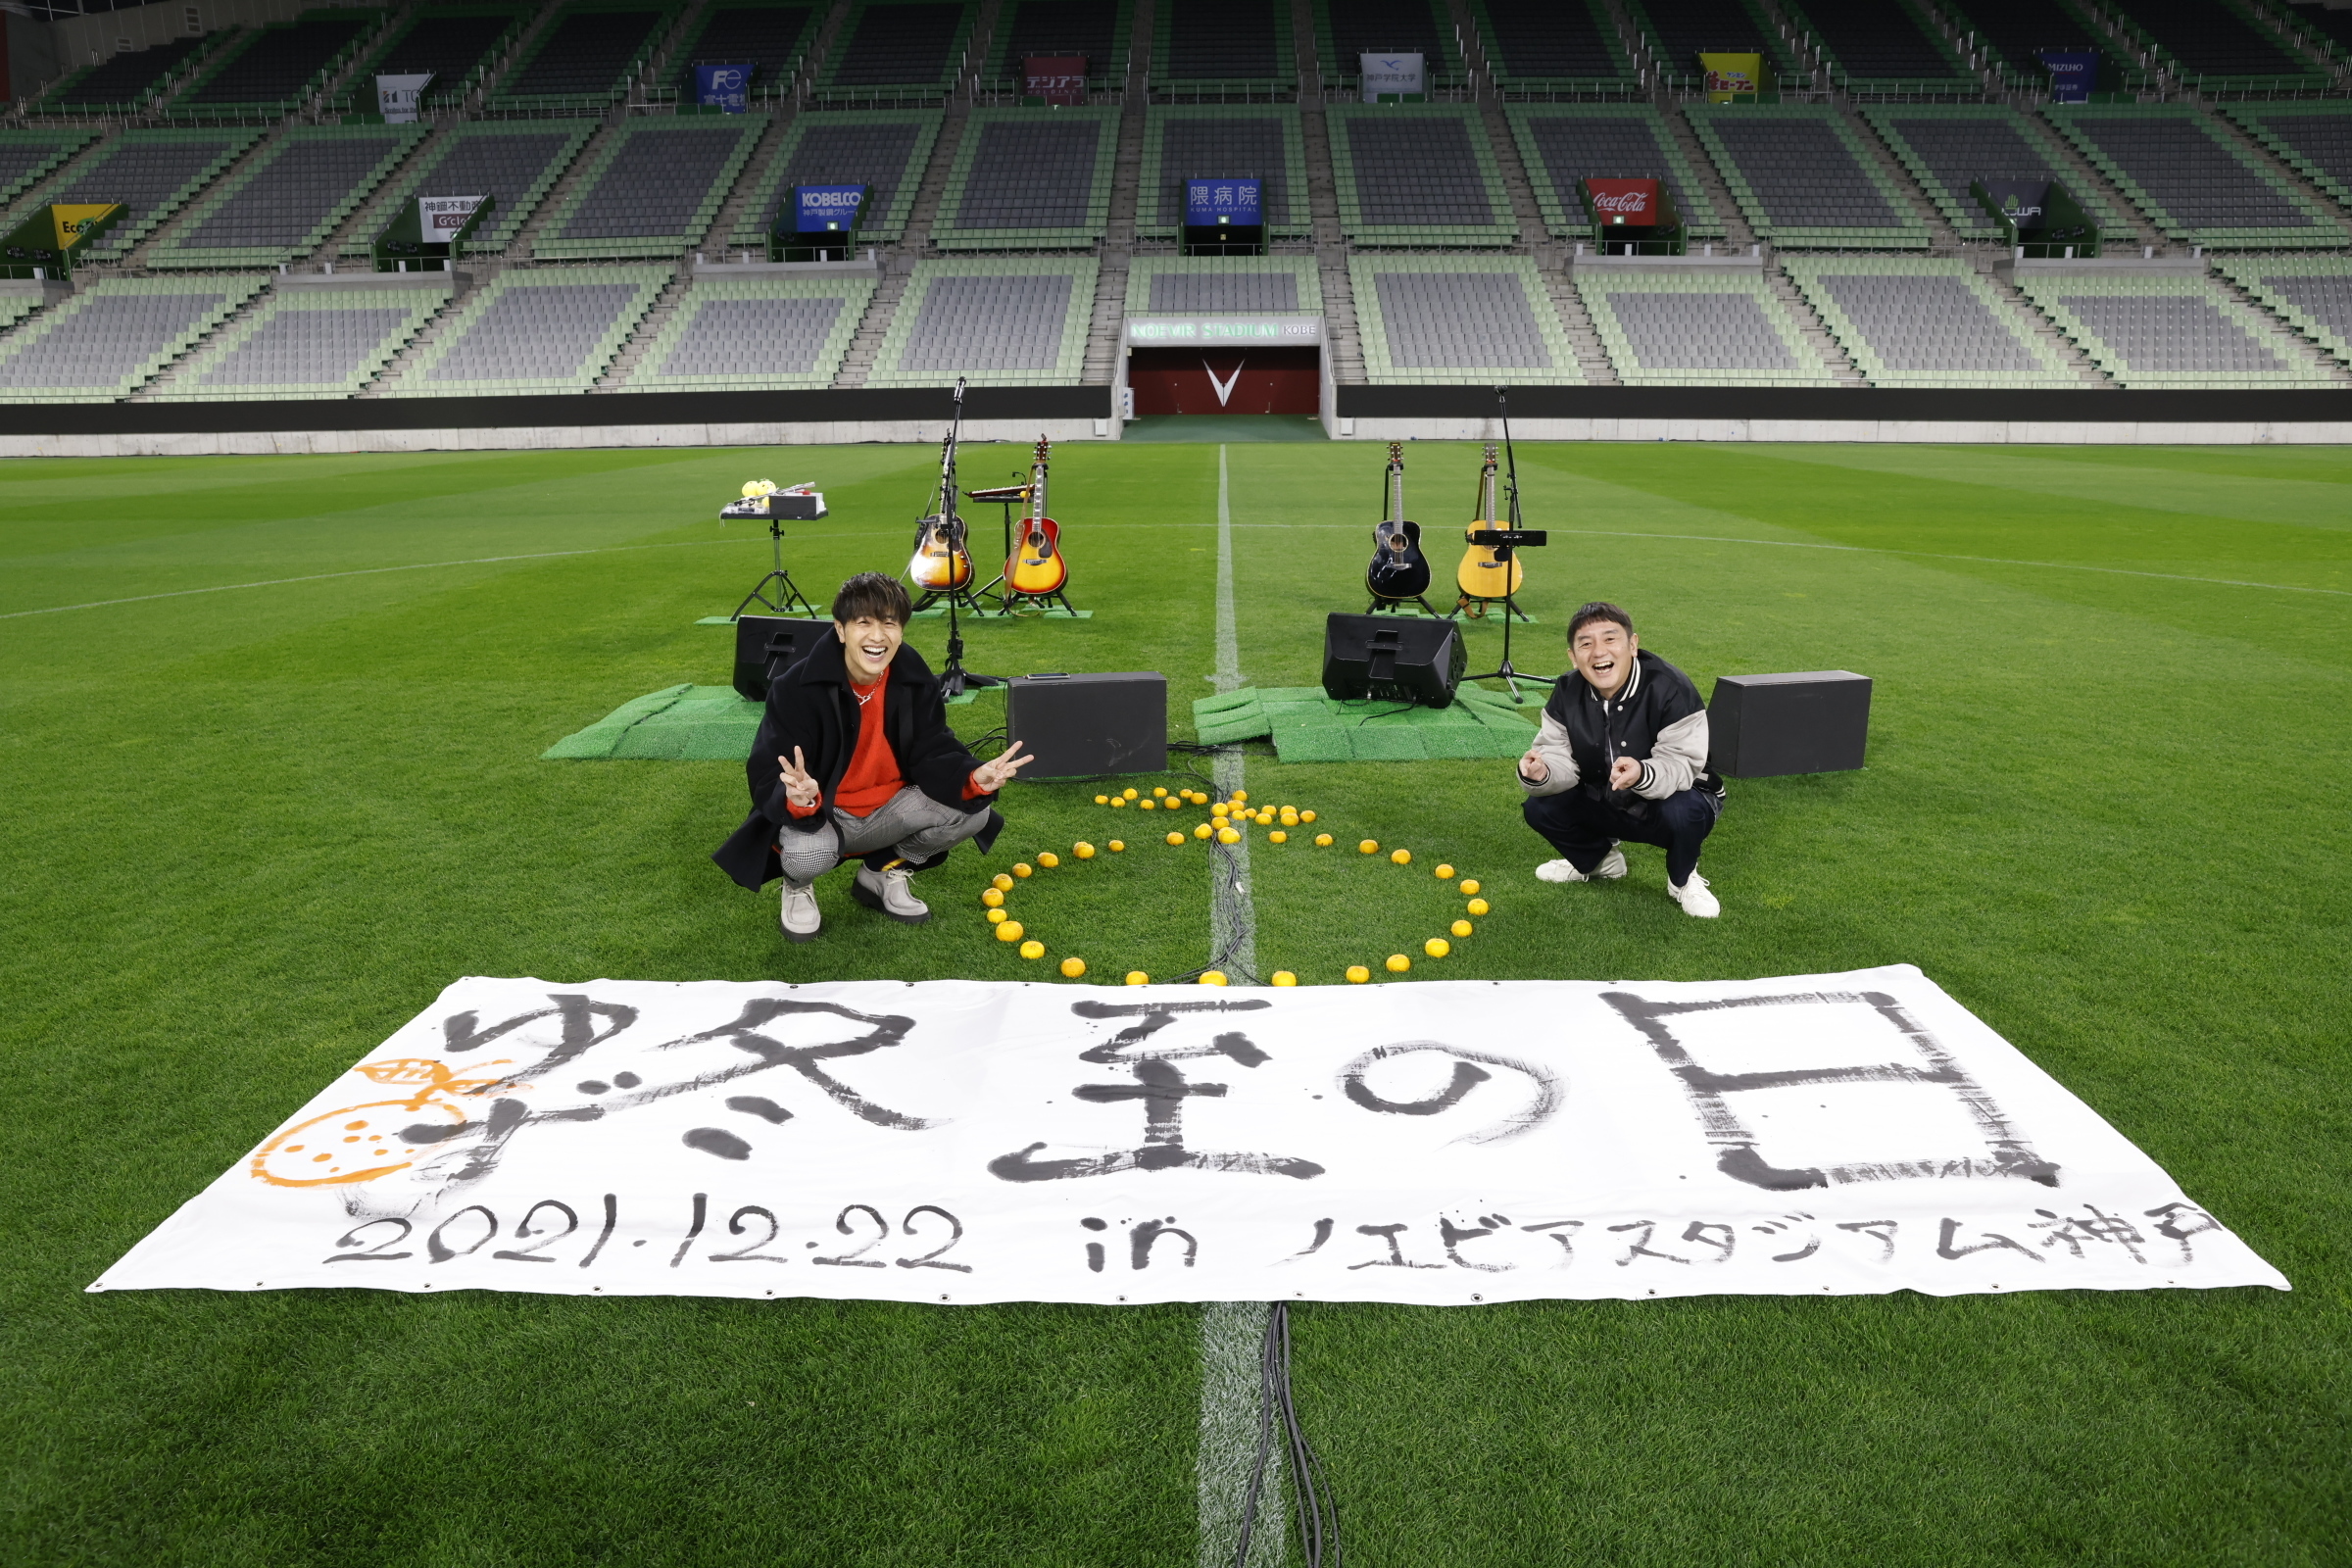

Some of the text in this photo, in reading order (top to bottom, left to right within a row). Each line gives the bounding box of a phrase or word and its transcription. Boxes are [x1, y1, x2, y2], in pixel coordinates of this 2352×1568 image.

[2047, 63, 2083, 72] MIZUHO
[1026, 75, 1085, 89] デジアラ
[1366, 74, 1416, 82] 神戸学院大学
[802, 191, 861, 208] KOBELCO
[1190, 185, 1257, 206] 隈病院
[1592, 192, 1648, 212] Coca-Cola
[803, 208, 858, 217] 神戸製鋼グルー
[1131, 323, 1316, 338] NOEVIR STADIUM KOBE
[1080, 1215, 1198, 1274] in
